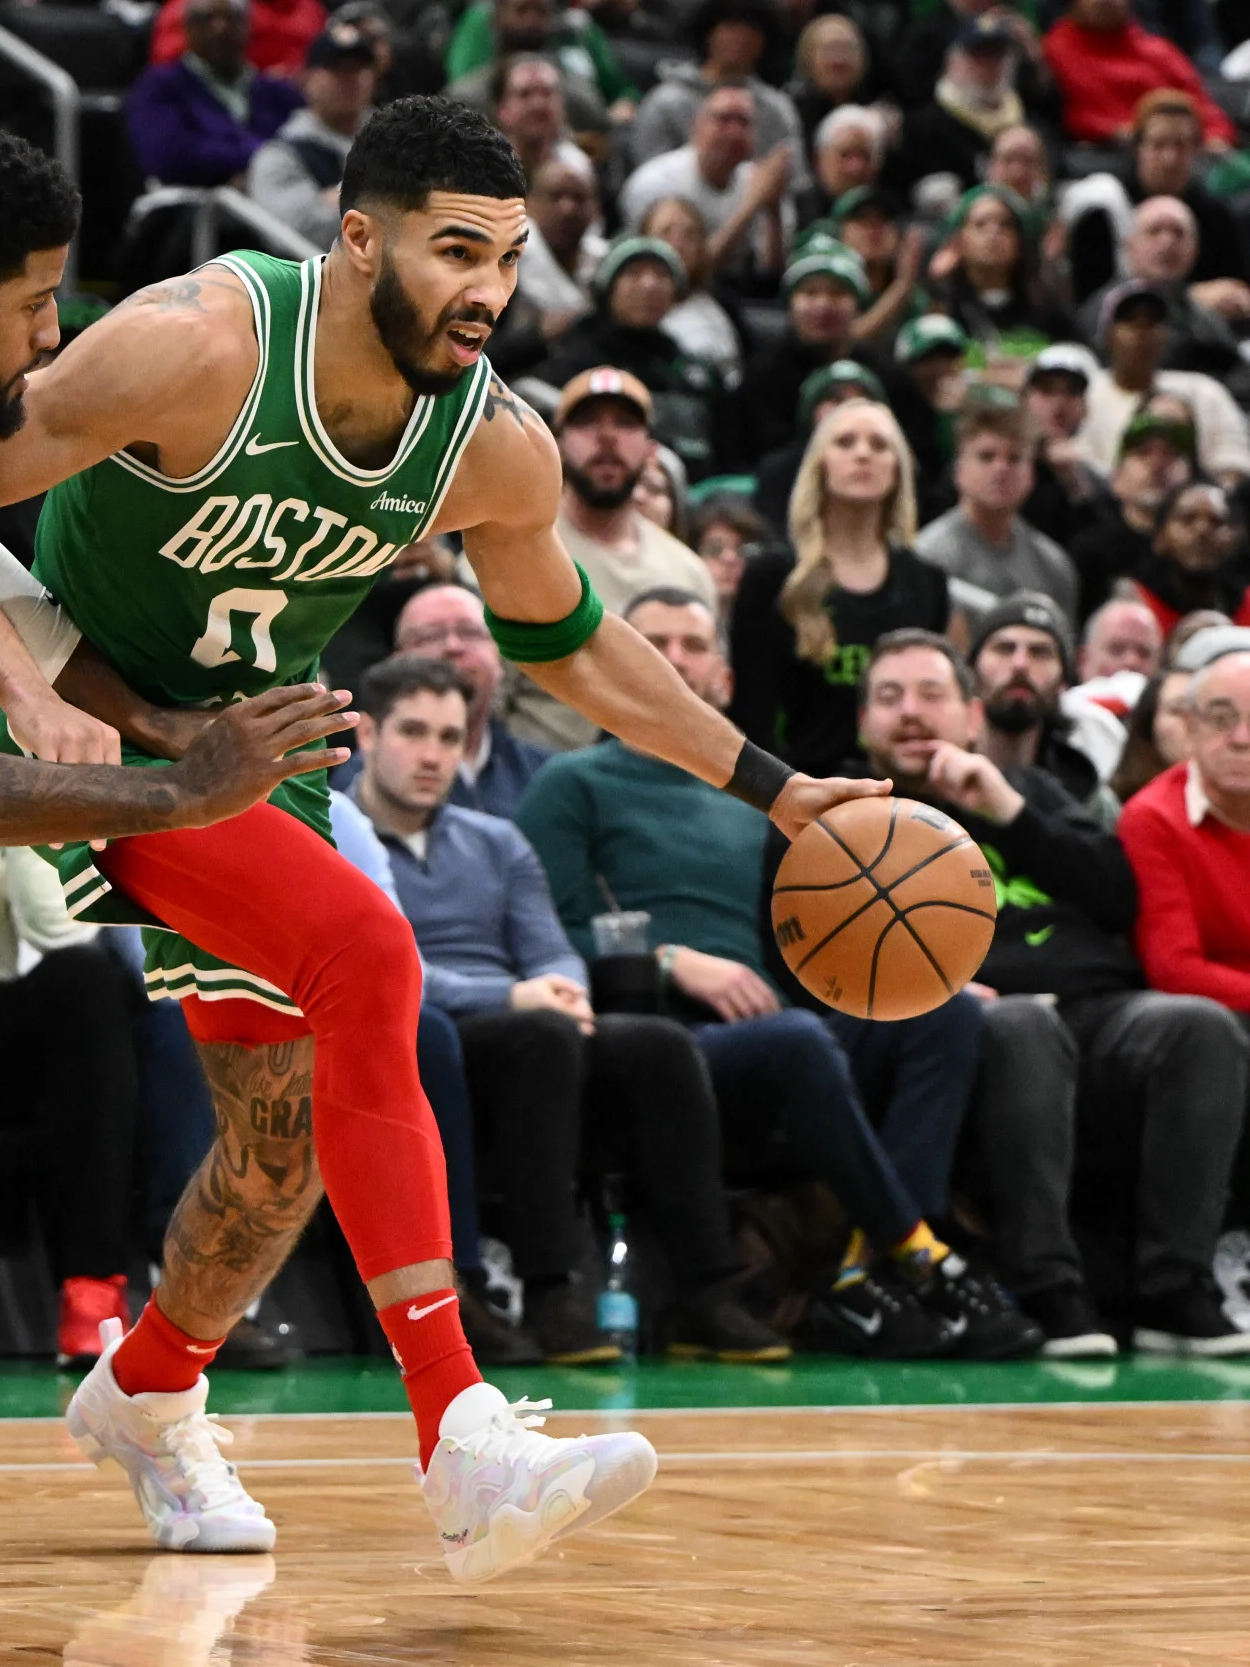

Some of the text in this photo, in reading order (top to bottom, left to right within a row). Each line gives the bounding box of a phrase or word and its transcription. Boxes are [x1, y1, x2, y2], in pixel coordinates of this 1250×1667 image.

[158, 493, 408, 581] BOSTON
[370, 490, 426, 514] Amica
[190, 587, 289, 673] 0
